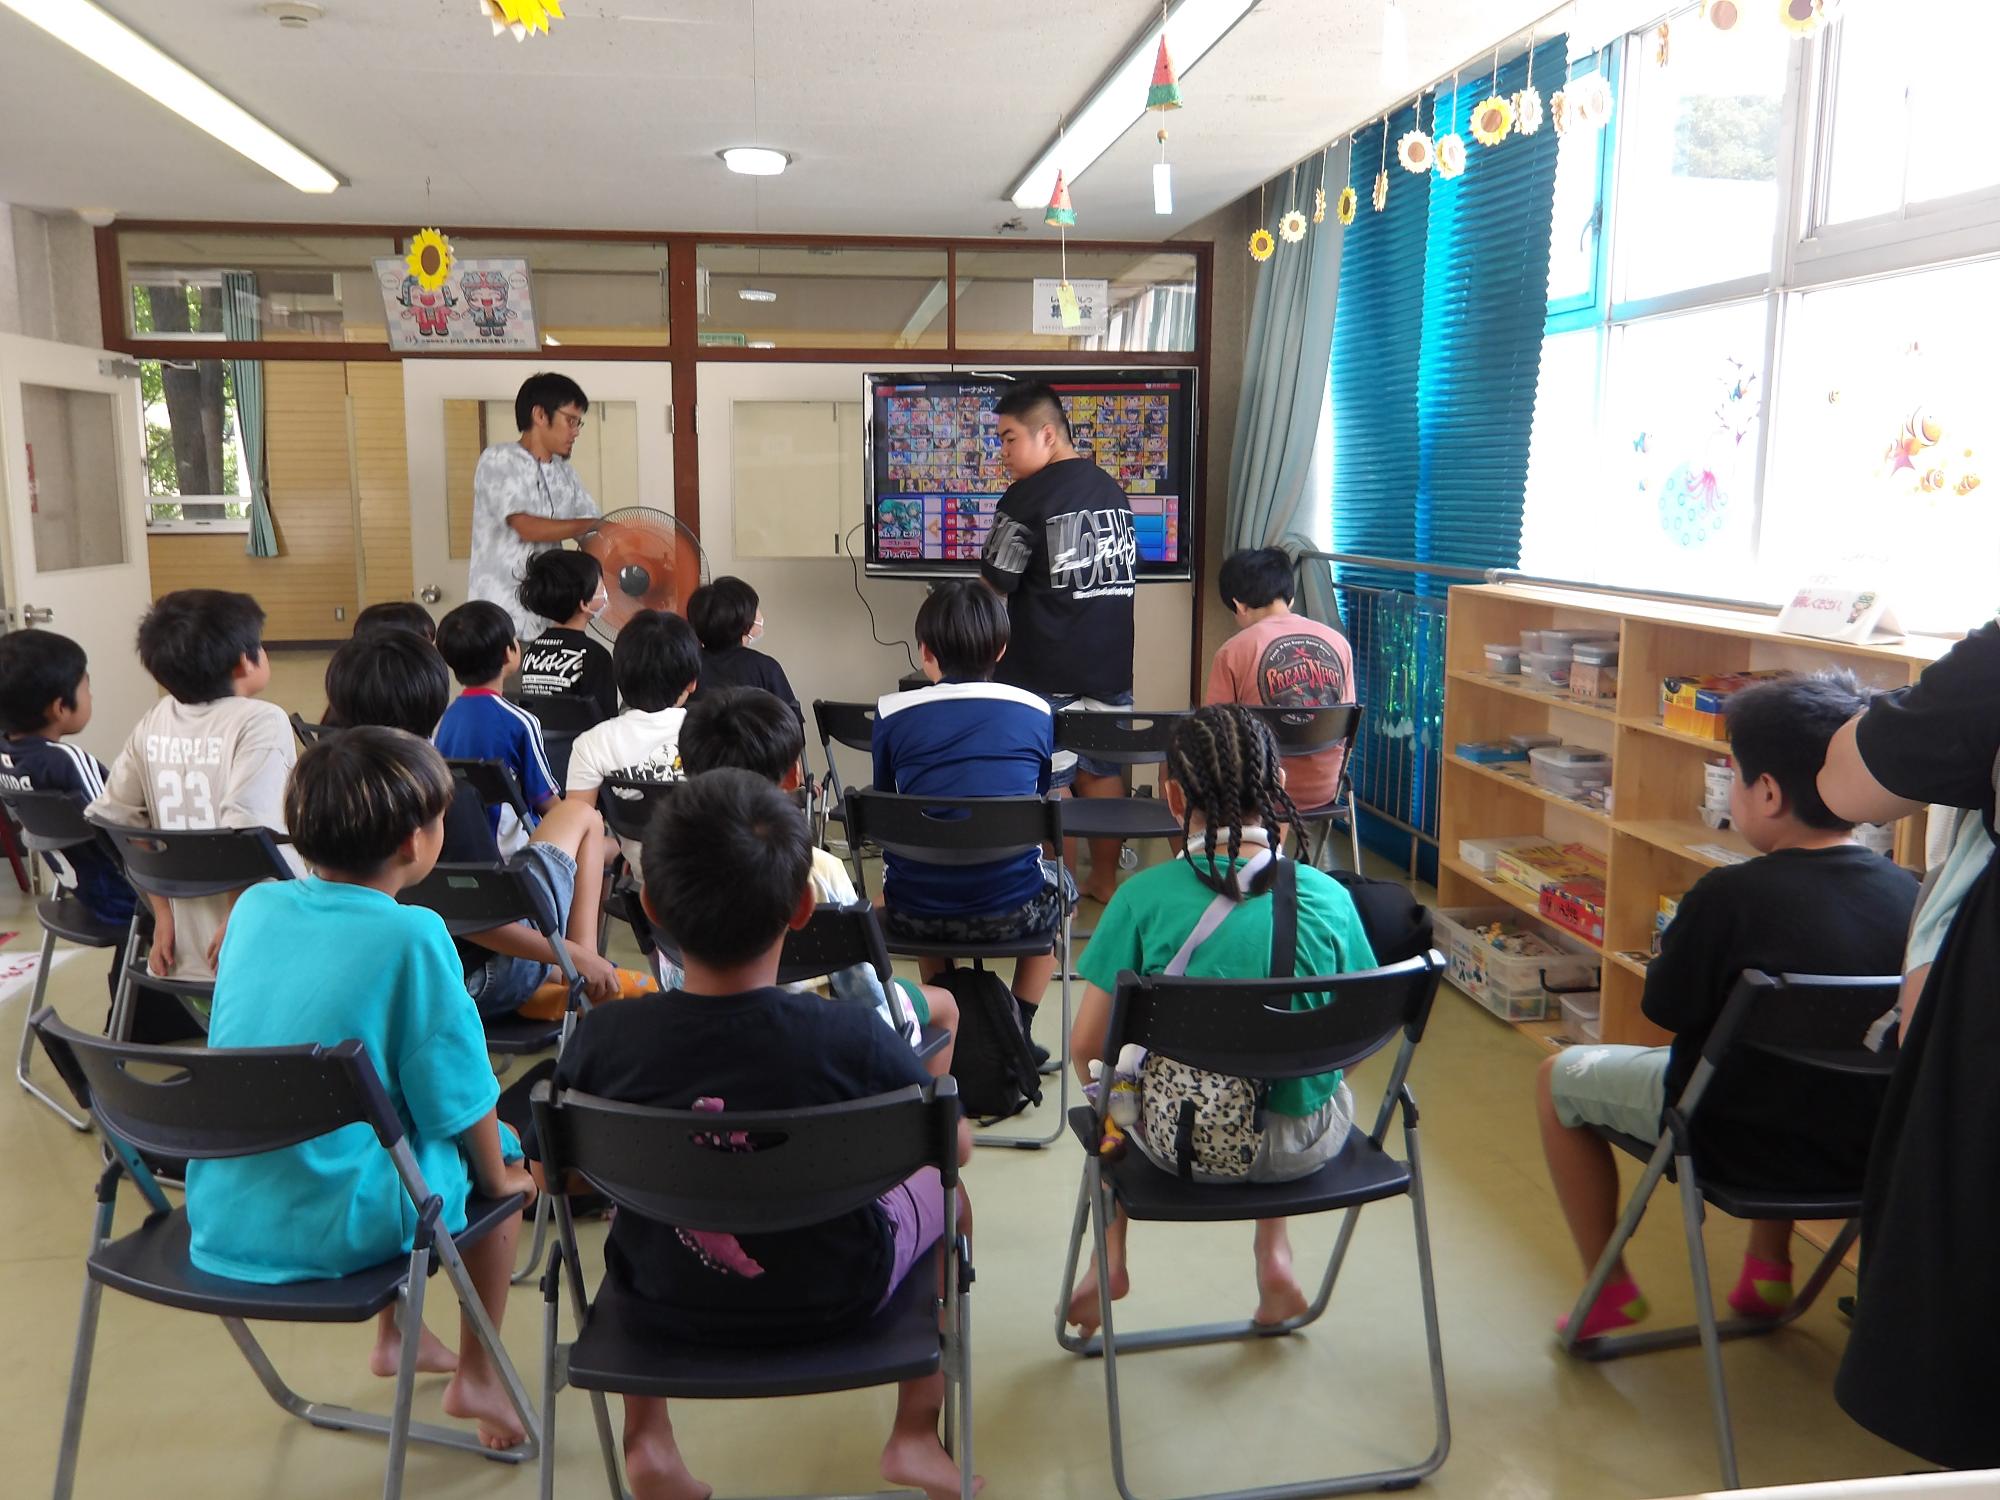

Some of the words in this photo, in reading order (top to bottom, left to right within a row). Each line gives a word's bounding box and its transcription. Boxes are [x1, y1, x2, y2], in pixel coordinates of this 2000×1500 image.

[959, 385, 996, 395] トーナメント
[146, 734, 223, 765] STAPLE
[157, 769, 217, 831] 23
